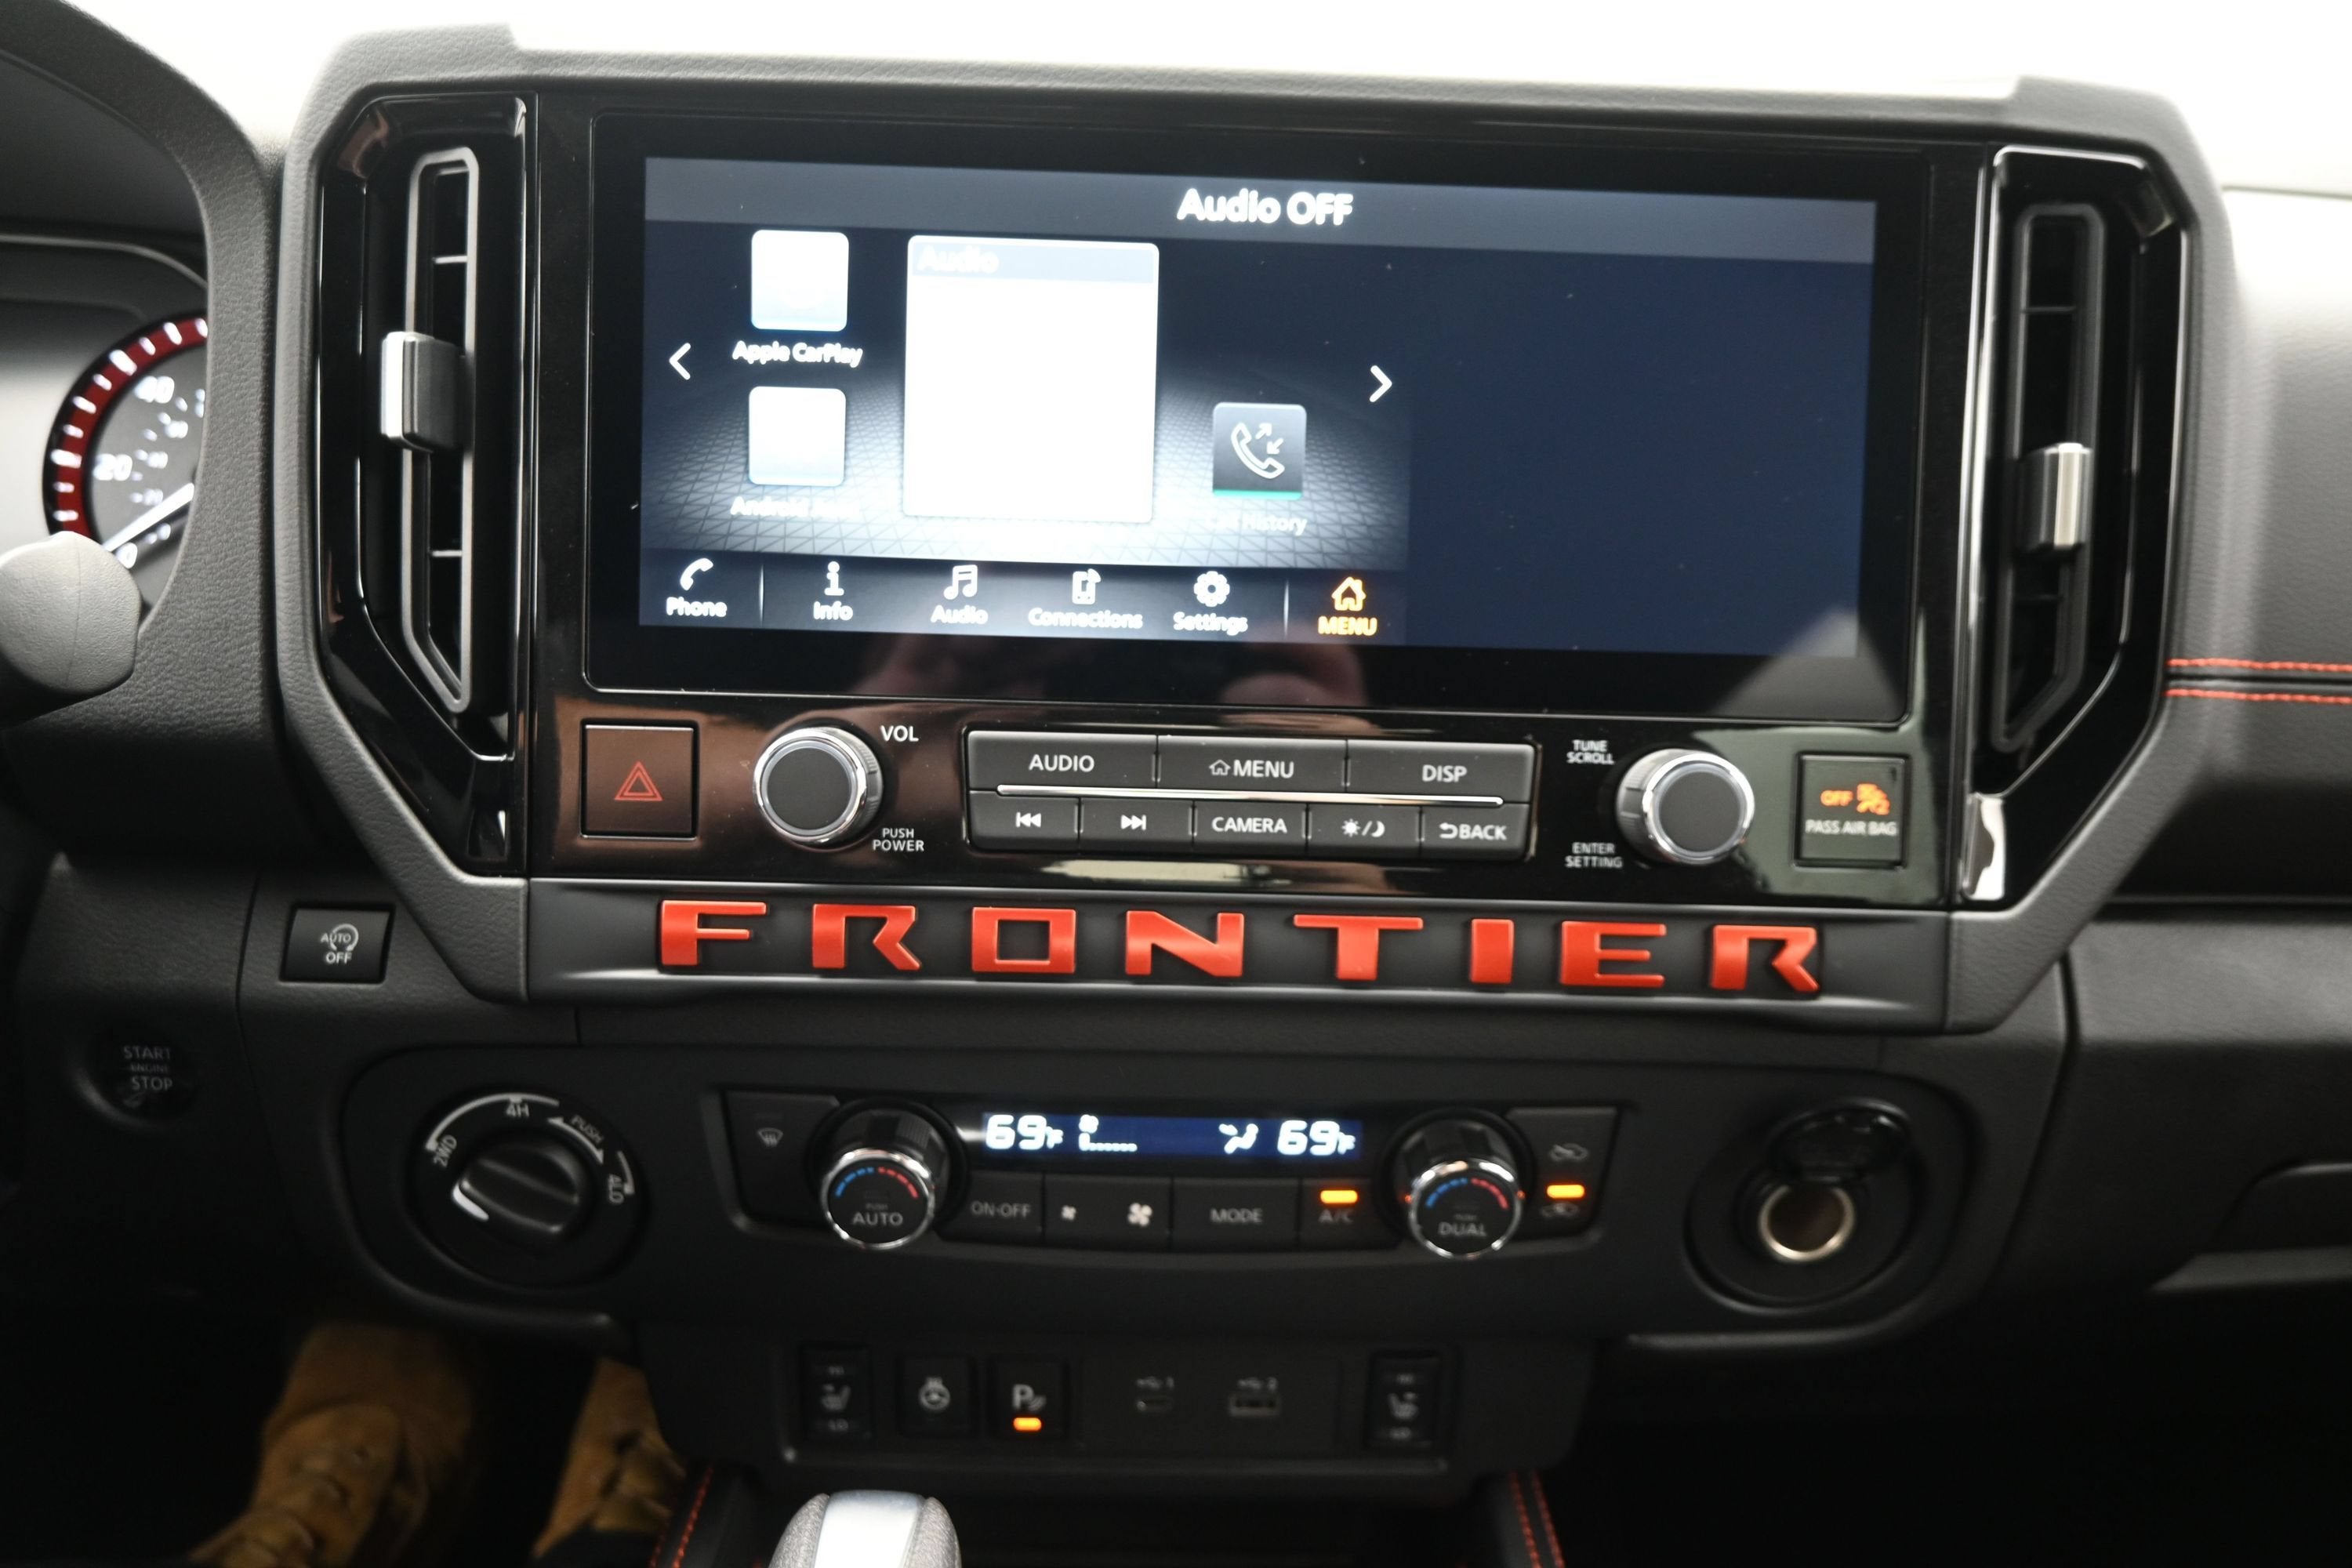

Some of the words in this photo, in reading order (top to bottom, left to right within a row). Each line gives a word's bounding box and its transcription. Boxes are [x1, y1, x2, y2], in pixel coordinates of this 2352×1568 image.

[1177, 187, 1280, 223] Audio
[1287, 191, 1354, 226] OFF
[917, 245, 1000, 274] Audio
[732, 341, 789, 365] Apple
[793, 343, 862, 368] CarPlay
[666, 597, 727, 618] Phone
[813, 601, 853, 620] Info
[931, 604, 988, 625] Audio
[1029, 607, 1142, 629] Connections
[1173, 612, 1248, 635] Settings
[1318, 615, 1377, 636] MENU
[880, 725, 919, 742] VOL
[1572, 739, 1607, 753] TUNE
[1029, 754, 1094, 772] AUDIO
[1566, 751, 1614, 765] SCROLL
[1233, 760, 1294, 778] MENU
[1422, 764, 1467, 783] DISP
[1820, 790, 1853, 806] OFF
[882, 828, 914, 839] PUSH
[1212, 817, 1287, 834] CAMERA
[1459, 823, 1507, 841] BACK
[1806, 819, 1839, 834] PASS
[1842, 820, 1866, 835] AIR
[1868, 821, 1897, 836] BAG
[873, 840, 924, 853] POWER
[1572, 842, 1615, 855] ENTER
[1566, 855, 1622, 869] SETTING
[321, 932, 352, 945] AUTO
[661, 900, 1820, 992] FRONTIER
[325, 952, 352, 964] OFF
[123, 1046, 171, 1059] START
[131, 1076, 172, 1091] STOP
[506, 1103, 529, 1117] 4H
[853, 1211, 903, 1225] AUTO
[1210, 1208, 1263, 1223] MODE
[1439, 1221, 1486, 1236] DUAL
